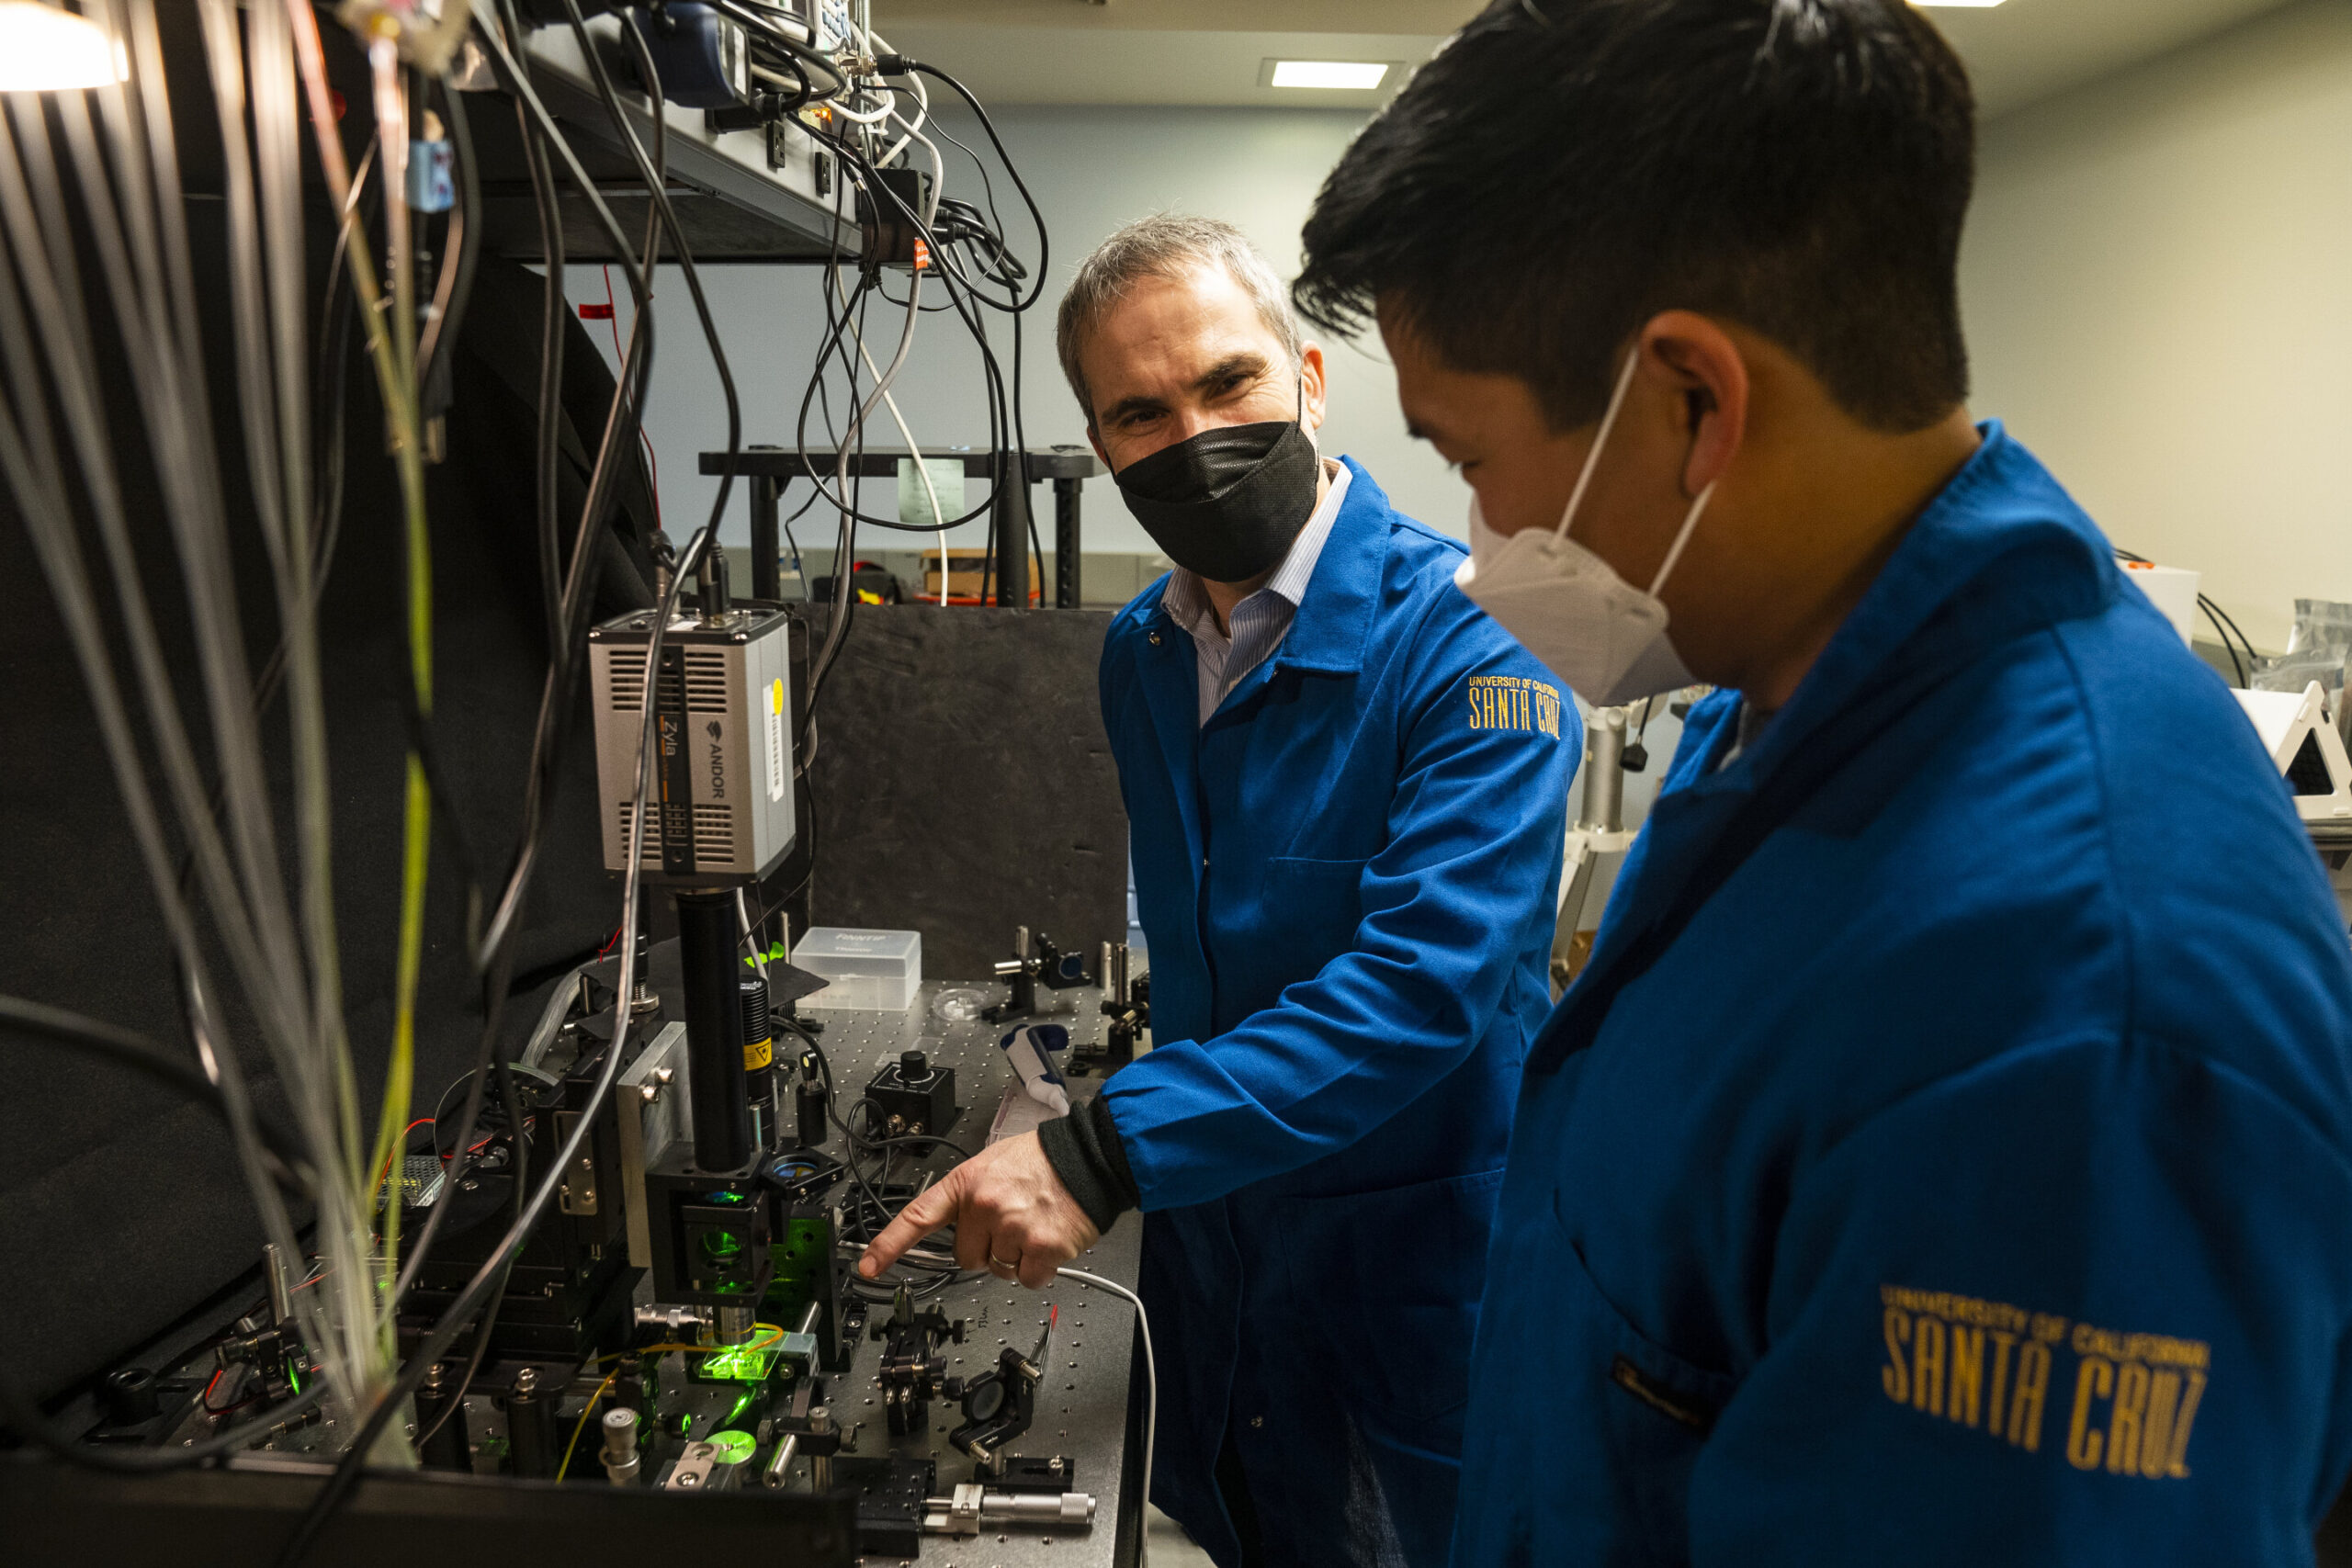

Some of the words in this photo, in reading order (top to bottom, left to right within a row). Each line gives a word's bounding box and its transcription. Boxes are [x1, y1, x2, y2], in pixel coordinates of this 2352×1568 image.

[1469, 676, 1521, 688] UNIVERSITY
[1521, 679, 1532, 689] OF
[662, 720, 678, 756] Zyla
[1469, 687, 1531, 731] SANTA
[1536, 692, 1561, 740] CRUZ
[710, 743, 725, 799] ANDOR
[1881, 1285, 2030, 1330] UNIVERSITY
[2030, 1313, 2067, 1343] OF
[2071, 1323, 2211, 1368] CALIFORNIA
[1882, 1306, 2052, 1452] SANTA
[2066, 1355, 2207, 1479] CRUZ
